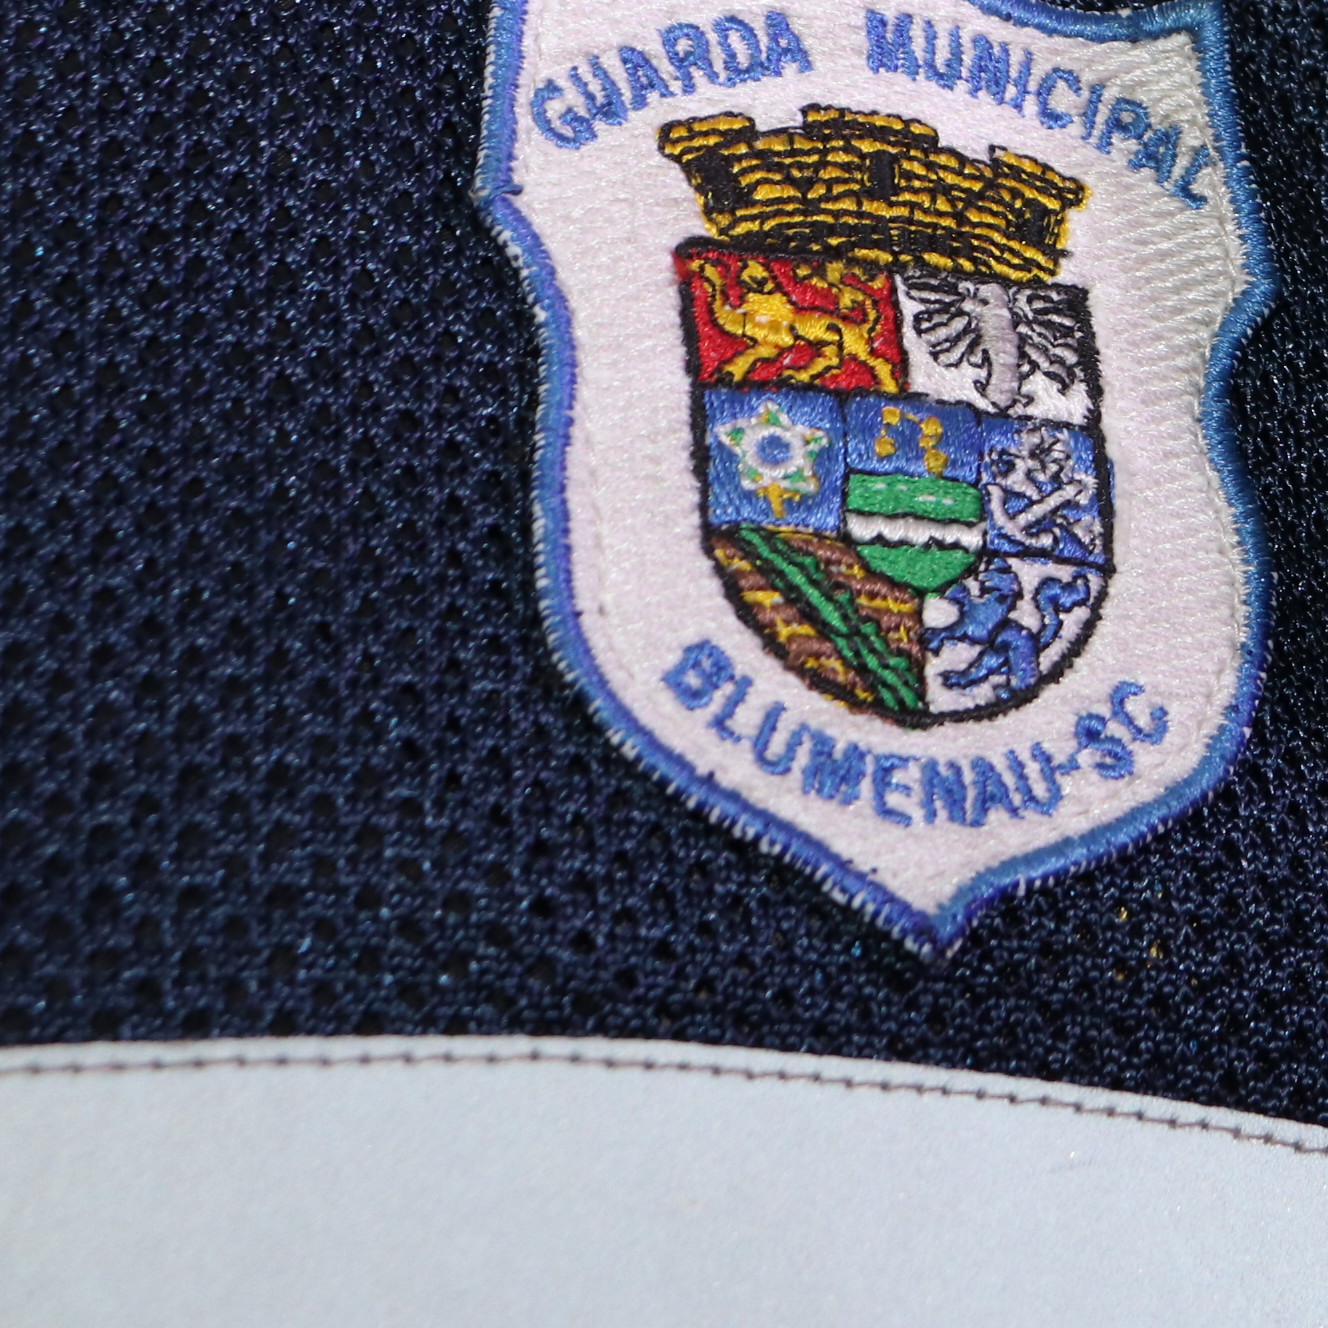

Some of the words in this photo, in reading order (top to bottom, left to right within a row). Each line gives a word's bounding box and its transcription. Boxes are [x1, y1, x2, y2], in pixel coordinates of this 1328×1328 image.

[531, 11, 813, 150] GUARDA
[866, 9, 1209, 209] MUNICIPAL
[661, 639, 1169, 827] BLUMENAU-SC
